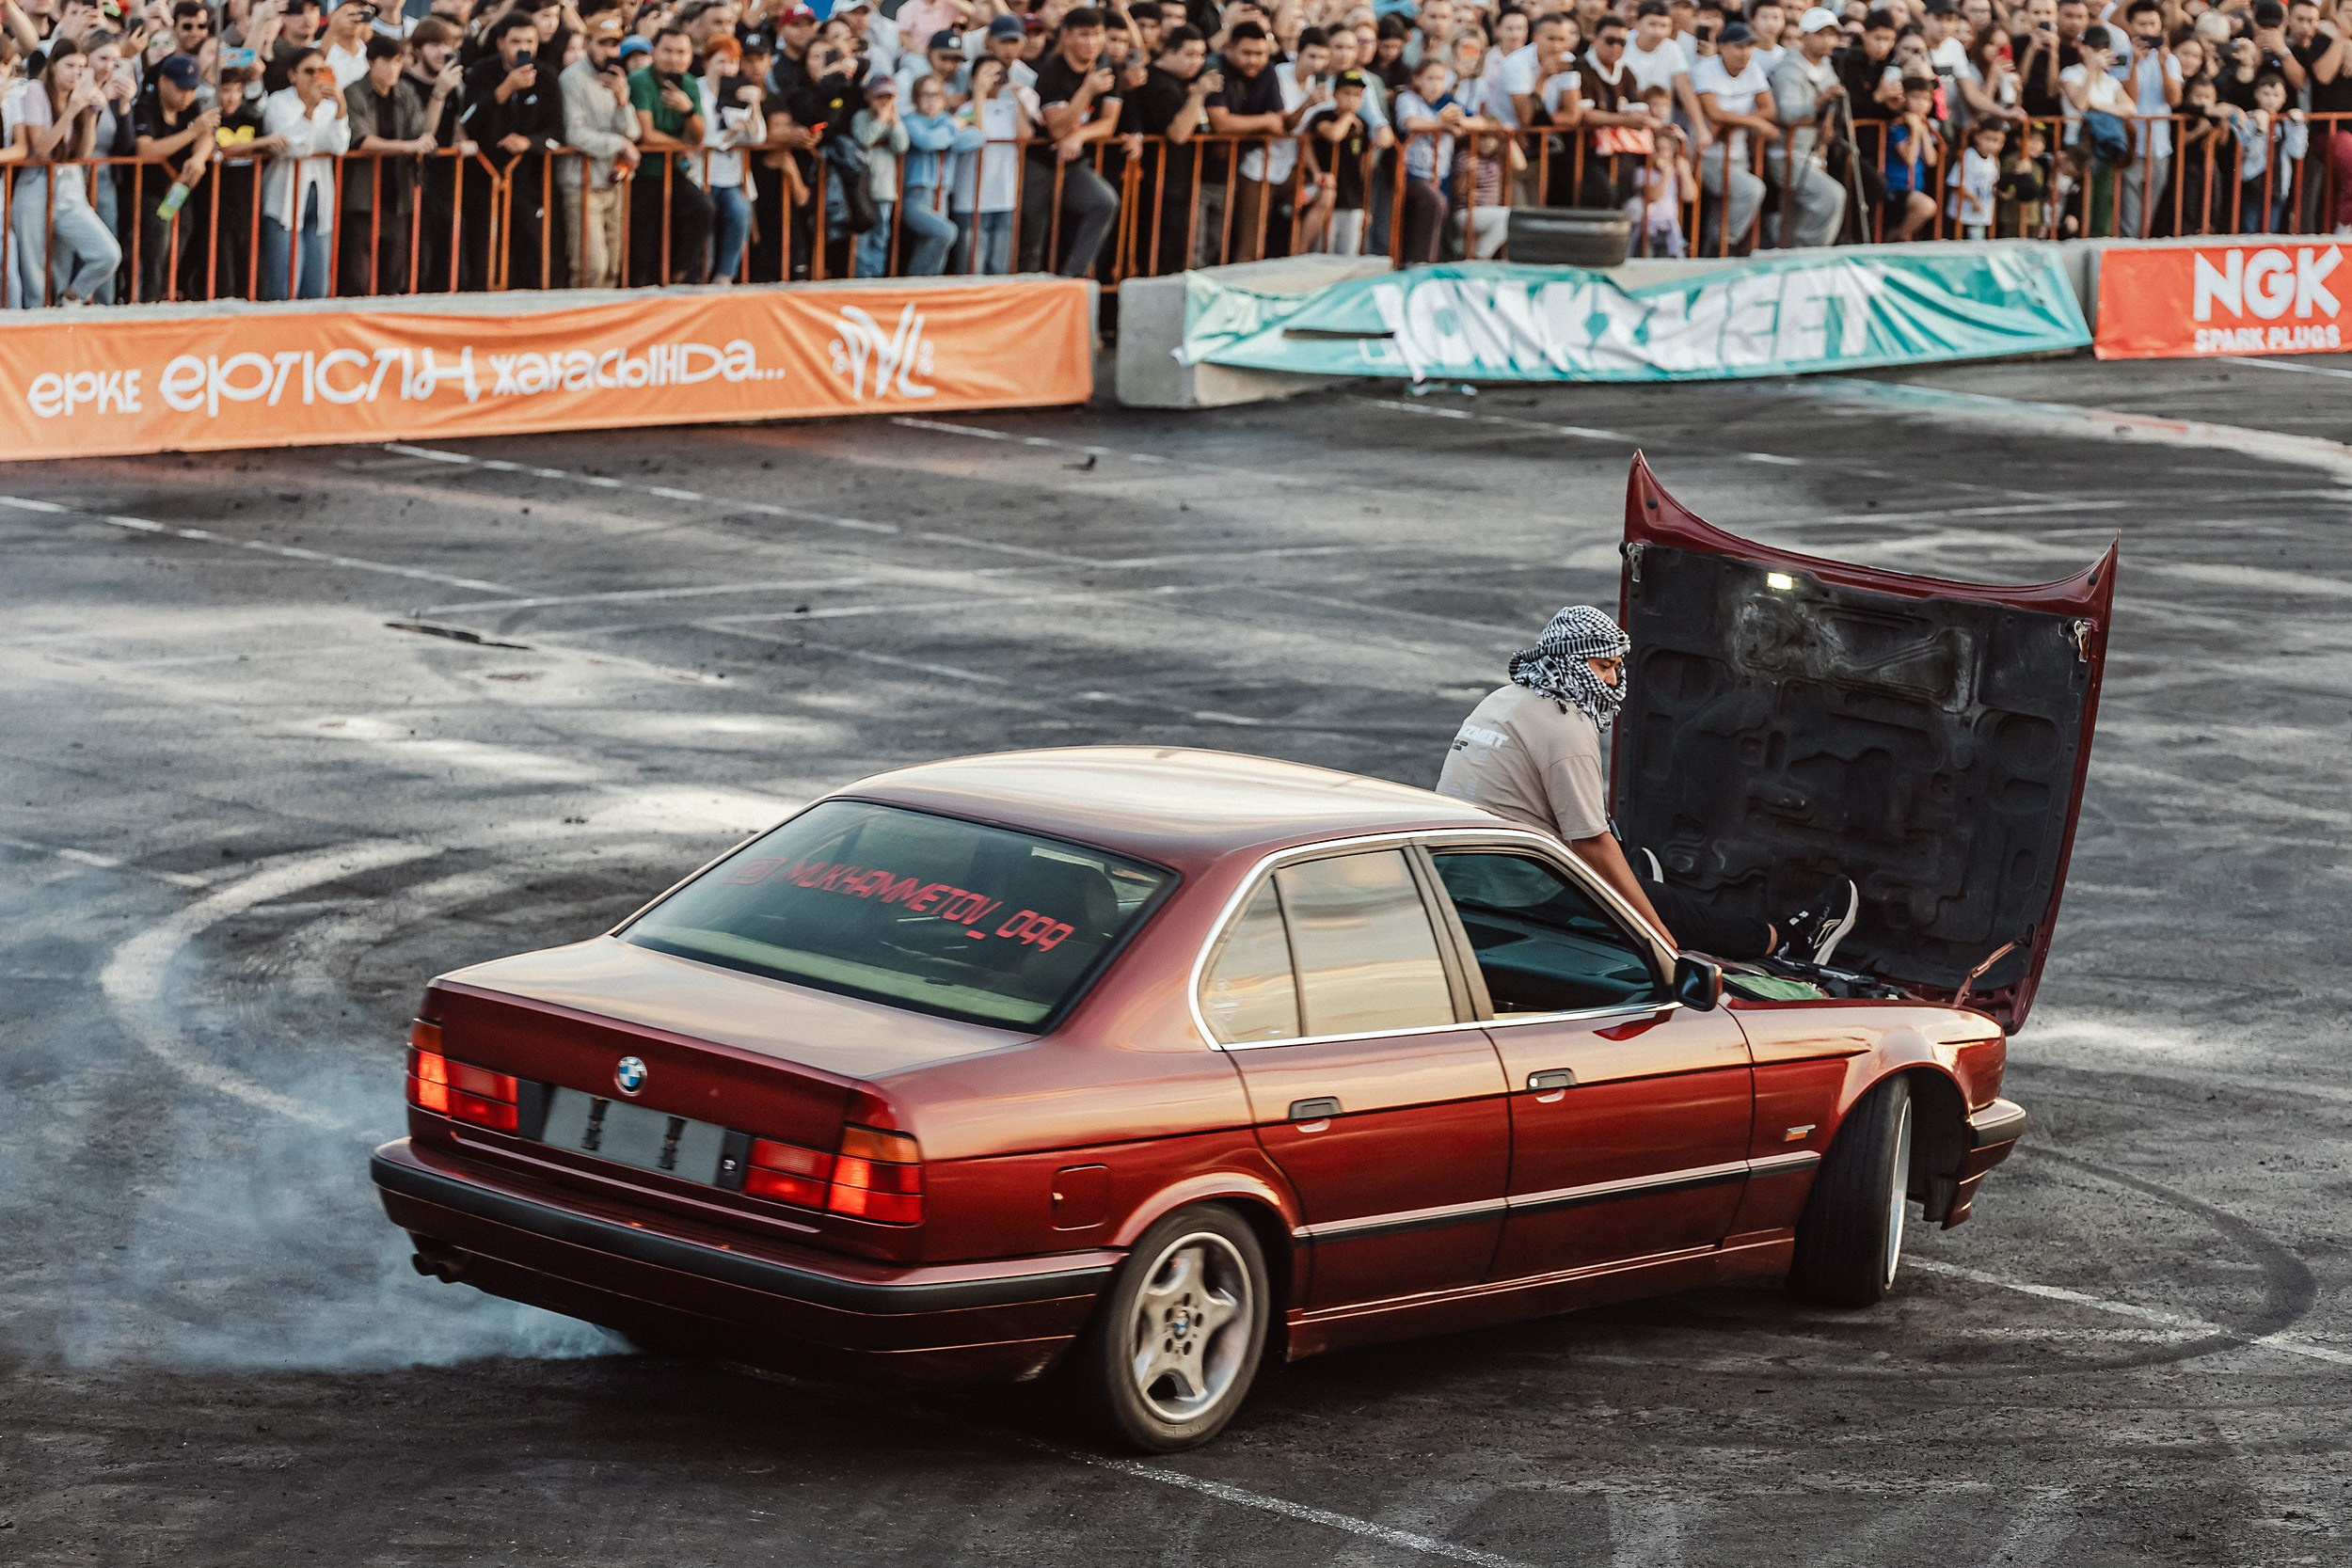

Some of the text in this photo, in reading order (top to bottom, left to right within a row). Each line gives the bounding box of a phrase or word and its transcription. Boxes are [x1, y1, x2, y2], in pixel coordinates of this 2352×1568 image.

[2193, 244, 2344, 323] NGK
[2194, 324, 2342, 353] SPARK PLUGS
